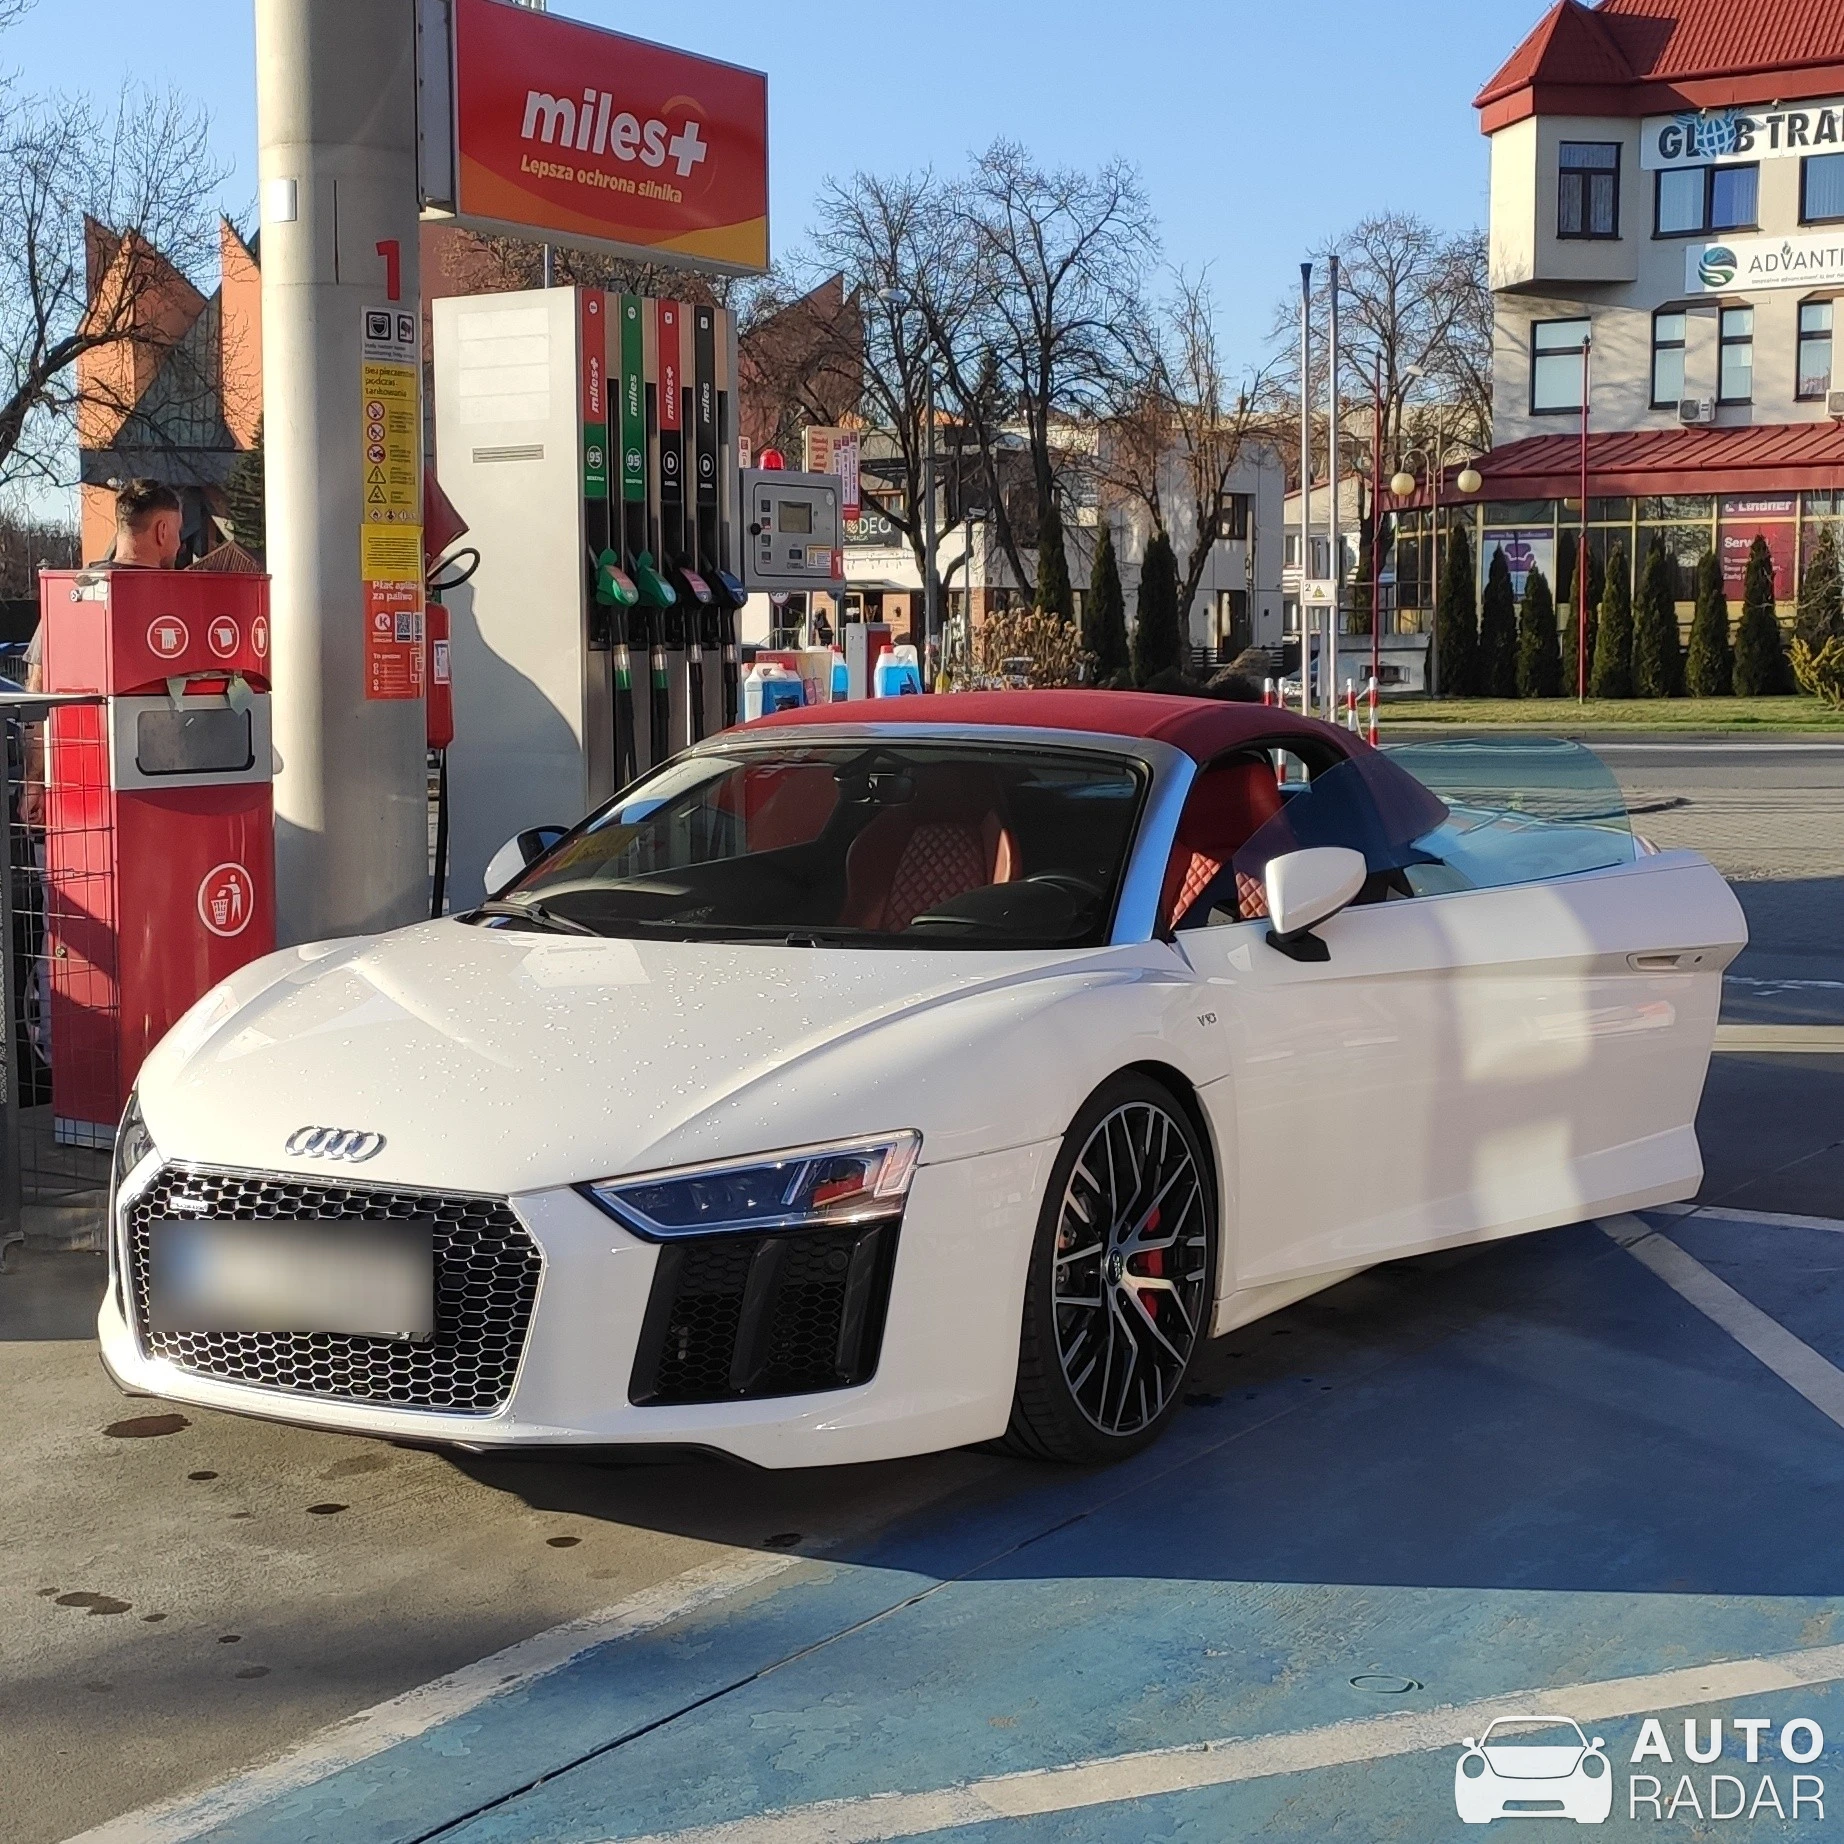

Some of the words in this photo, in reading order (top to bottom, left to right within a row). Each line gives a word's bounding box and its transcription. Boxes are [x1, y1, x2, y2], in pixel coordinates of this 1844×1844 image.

[1766, 107, 1844, 149] TRA
[521, 155, 573, 182] Lepsza
[577, 168, 635, 195] ochrona
[638, 180, 683, 203] silnika
[376, 239, 400, 301] 1
[589, 452, 601, 462] 95
[627, 454, 640, 466] 95
[667, 457, 675, 469] D
[702, 459, 710, 472] D
